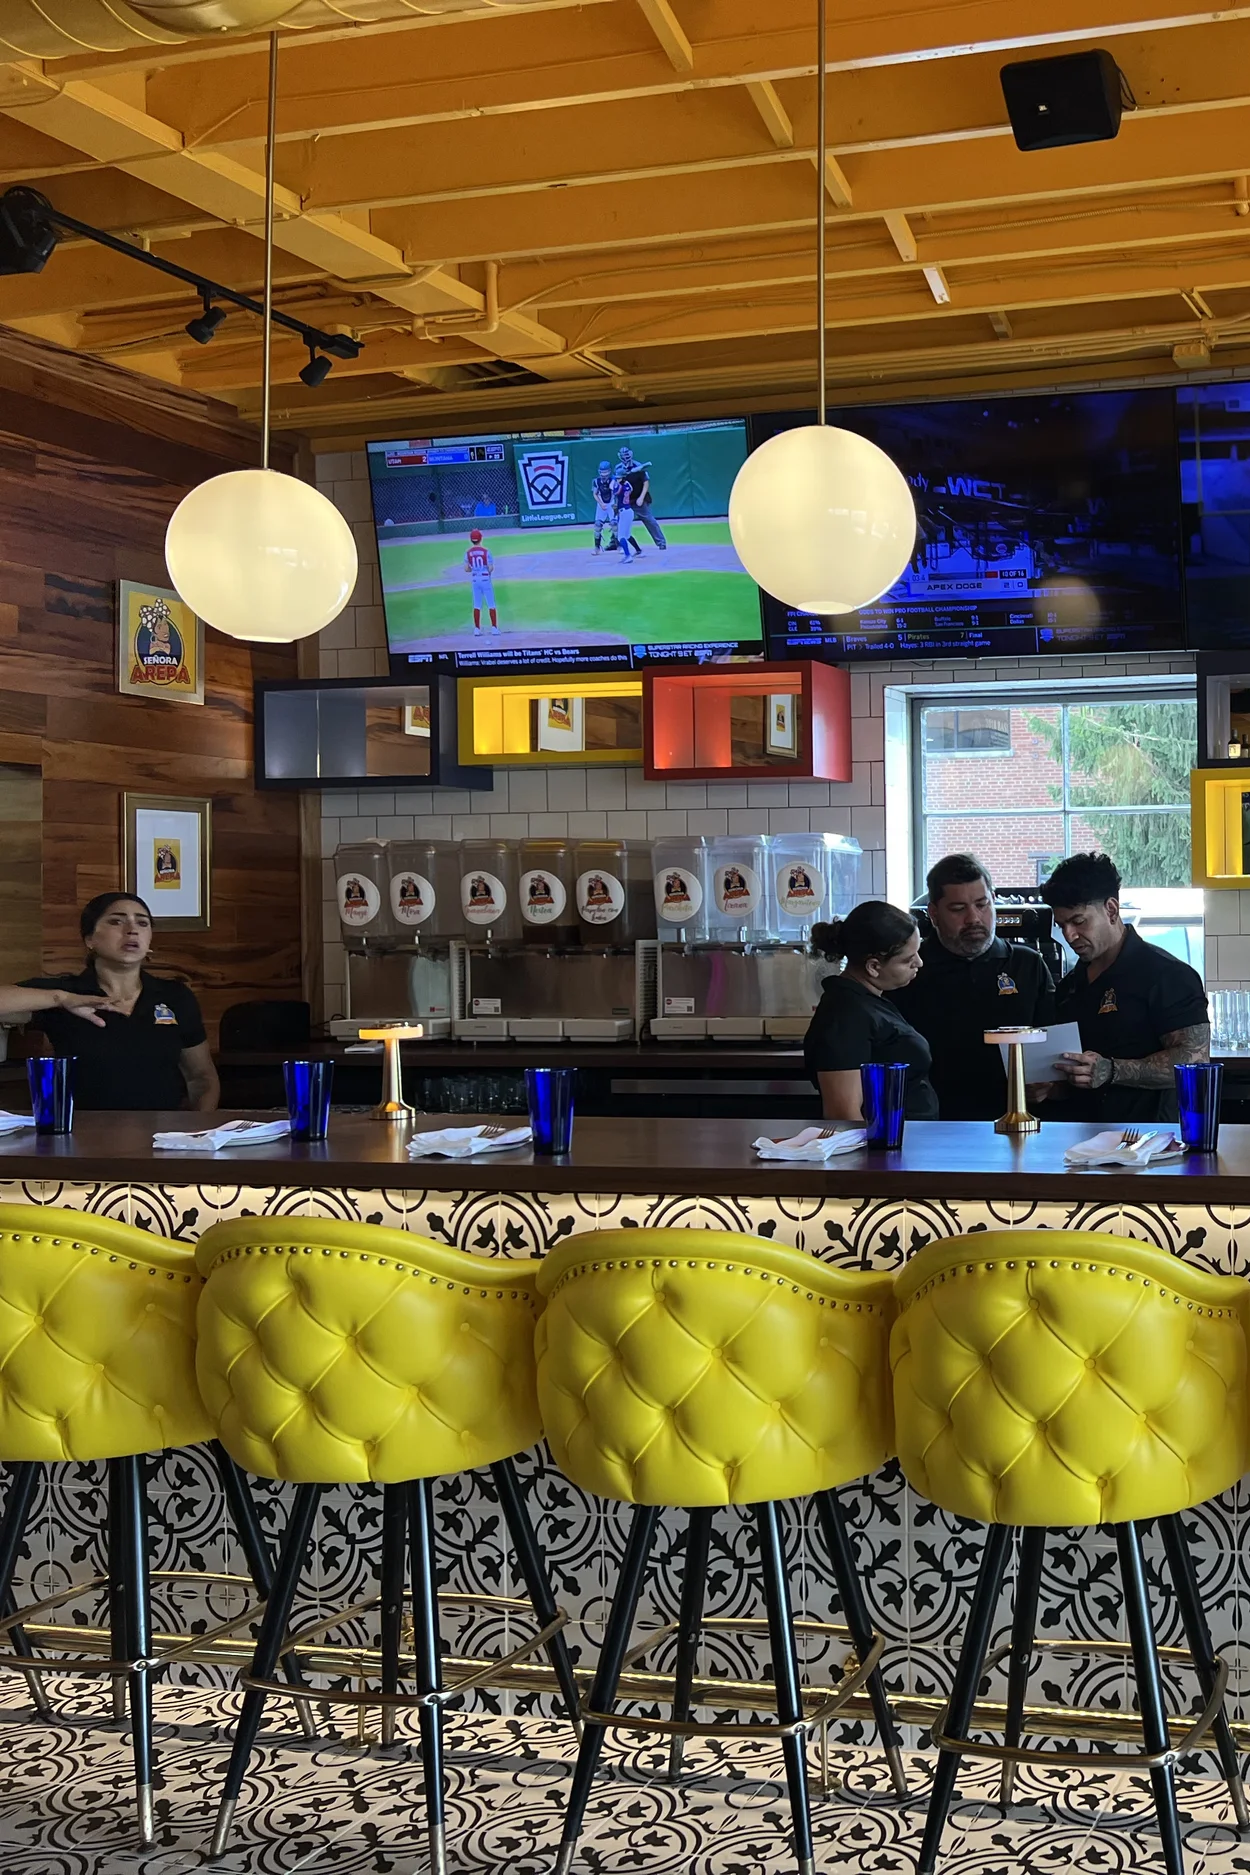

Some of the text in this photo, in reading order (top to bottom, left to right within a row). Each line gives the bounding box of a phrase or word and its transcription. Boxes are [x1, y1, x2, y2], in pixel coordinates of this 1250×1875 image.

[521, 513, 575, 522] LittleLeague.org
[472, 556, 484, 568] 10
[144, 655, 178, 666] SEÑORA
[408, 654, 433, 663] ESPN
[130, 665, 190, 684] AREPA
